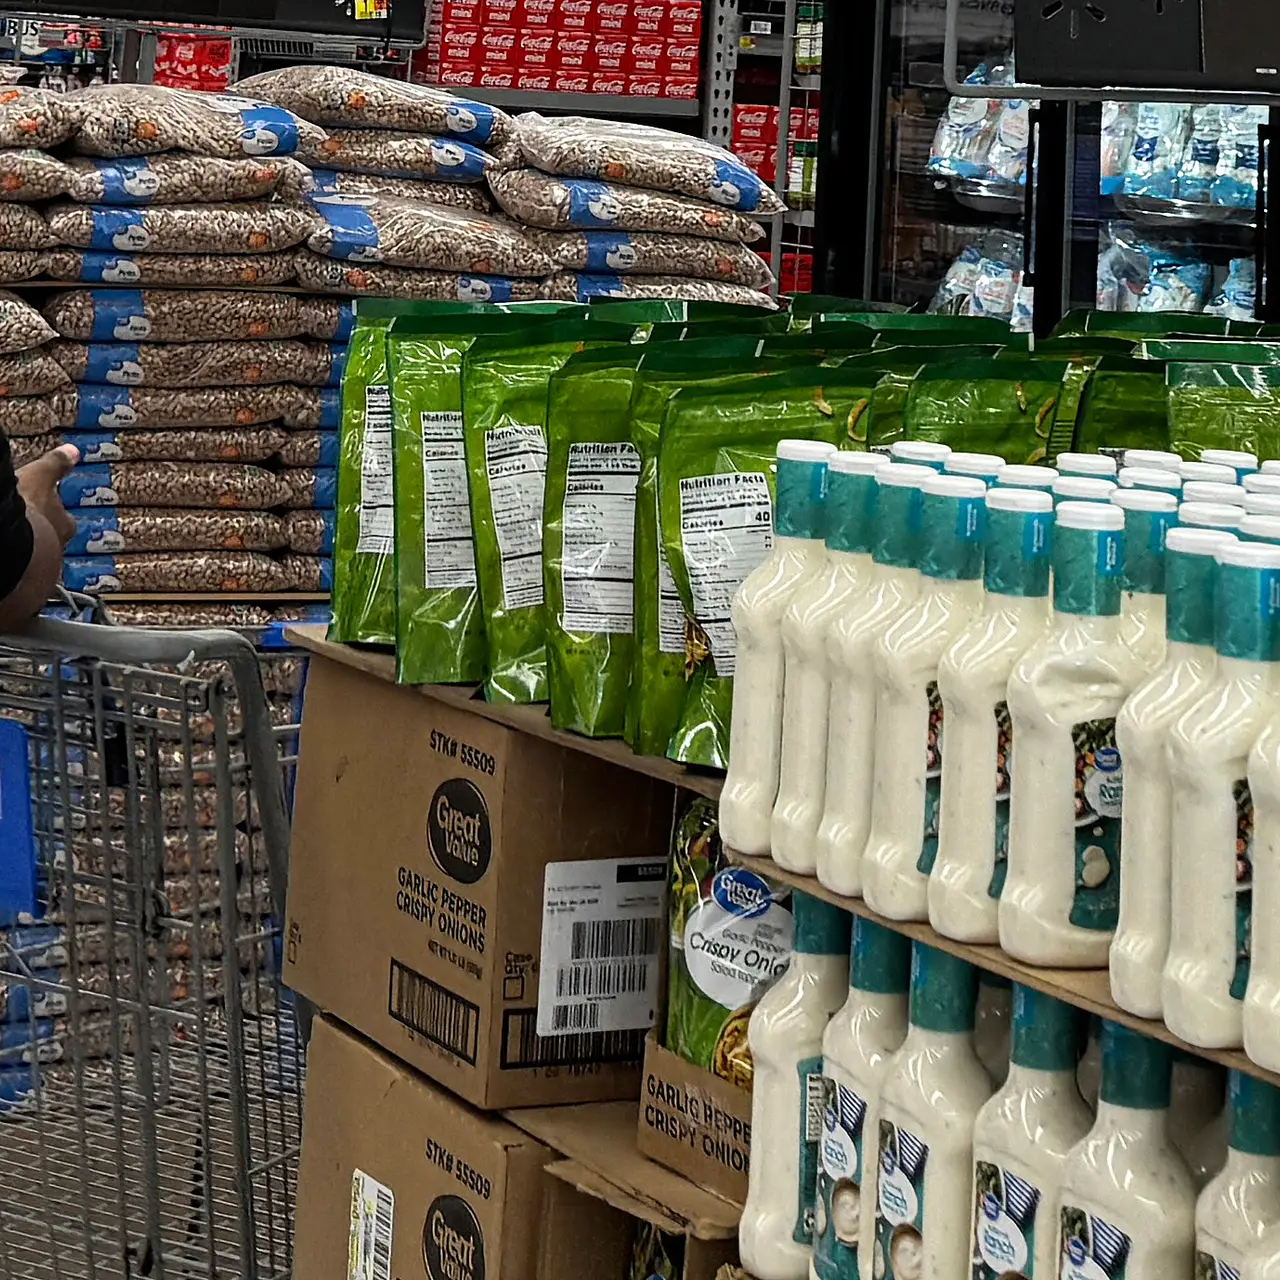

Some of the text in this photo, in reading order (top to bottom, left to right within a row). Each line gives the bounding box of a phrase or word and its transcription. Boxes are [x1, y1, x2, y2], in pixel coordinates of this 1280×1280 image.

[430, 729, 496, 776] STK# 55509
[437, 794, 481, 846] Great
[444, 830, 479, 867] Value
[398, 866, 487, 928] GARLIC PEPPER
[720, 873, 765, 901] Great
[396, 890, 485, 954] CRISPY ONIONS
[689, 931, 741, 963] Crispy
[646, 1073, 699, 1120] GARLIC
[645, 1104, 696, 1147] CRISPY
[425, 1137, 491, 1200] STK# 55509
[432, 1209, 476, 1272] Great
